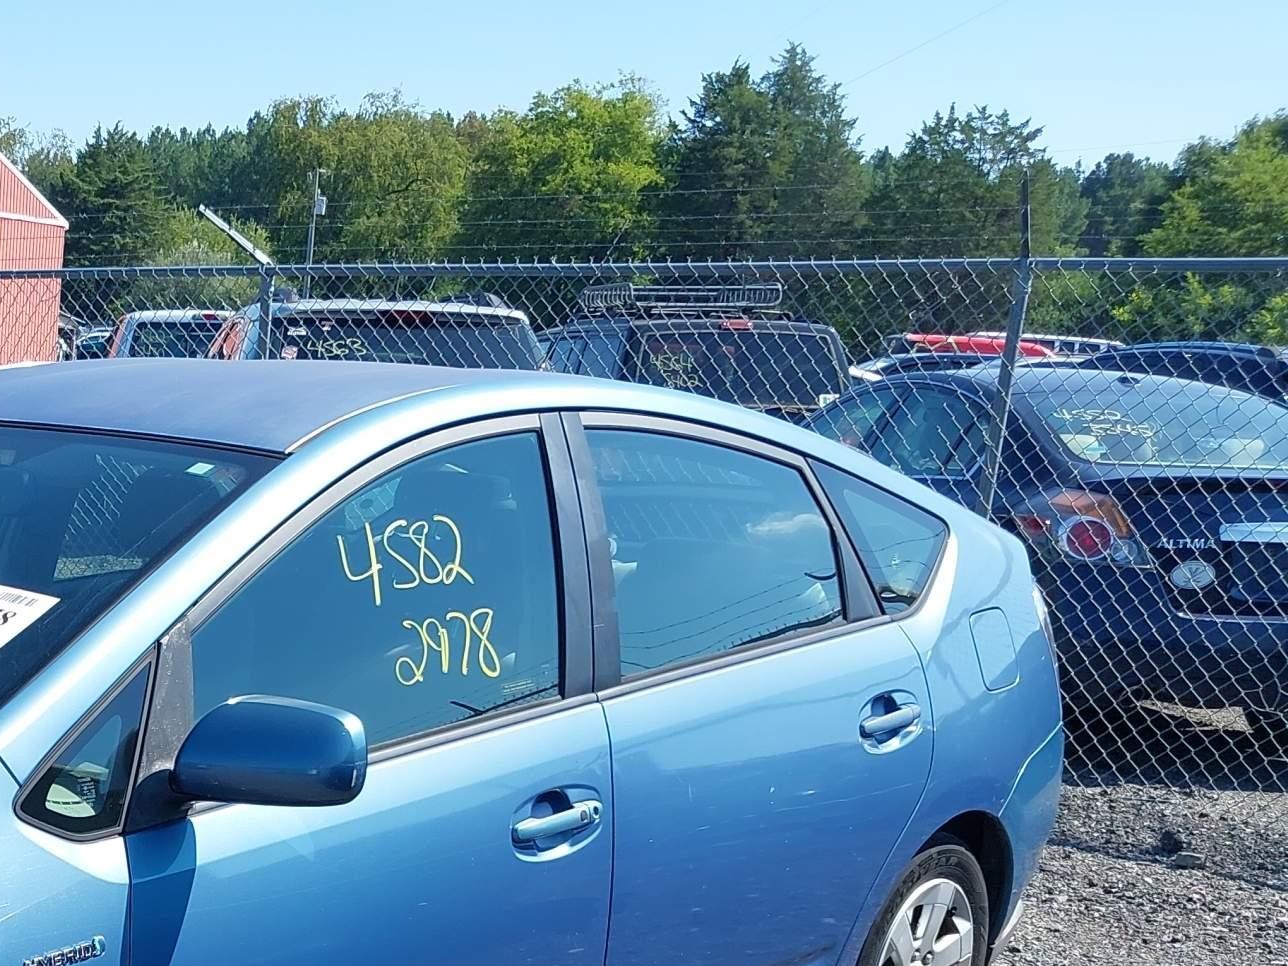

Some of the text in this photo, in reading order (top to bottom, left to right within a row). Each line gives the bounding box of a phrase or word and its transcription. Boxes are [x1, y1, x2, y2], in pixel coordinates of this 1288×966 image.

[337, 514, 475, 606] 4582
[1156, 538, 1216, 549] ALTIMA
[395, 607, 501, 686] 2978
